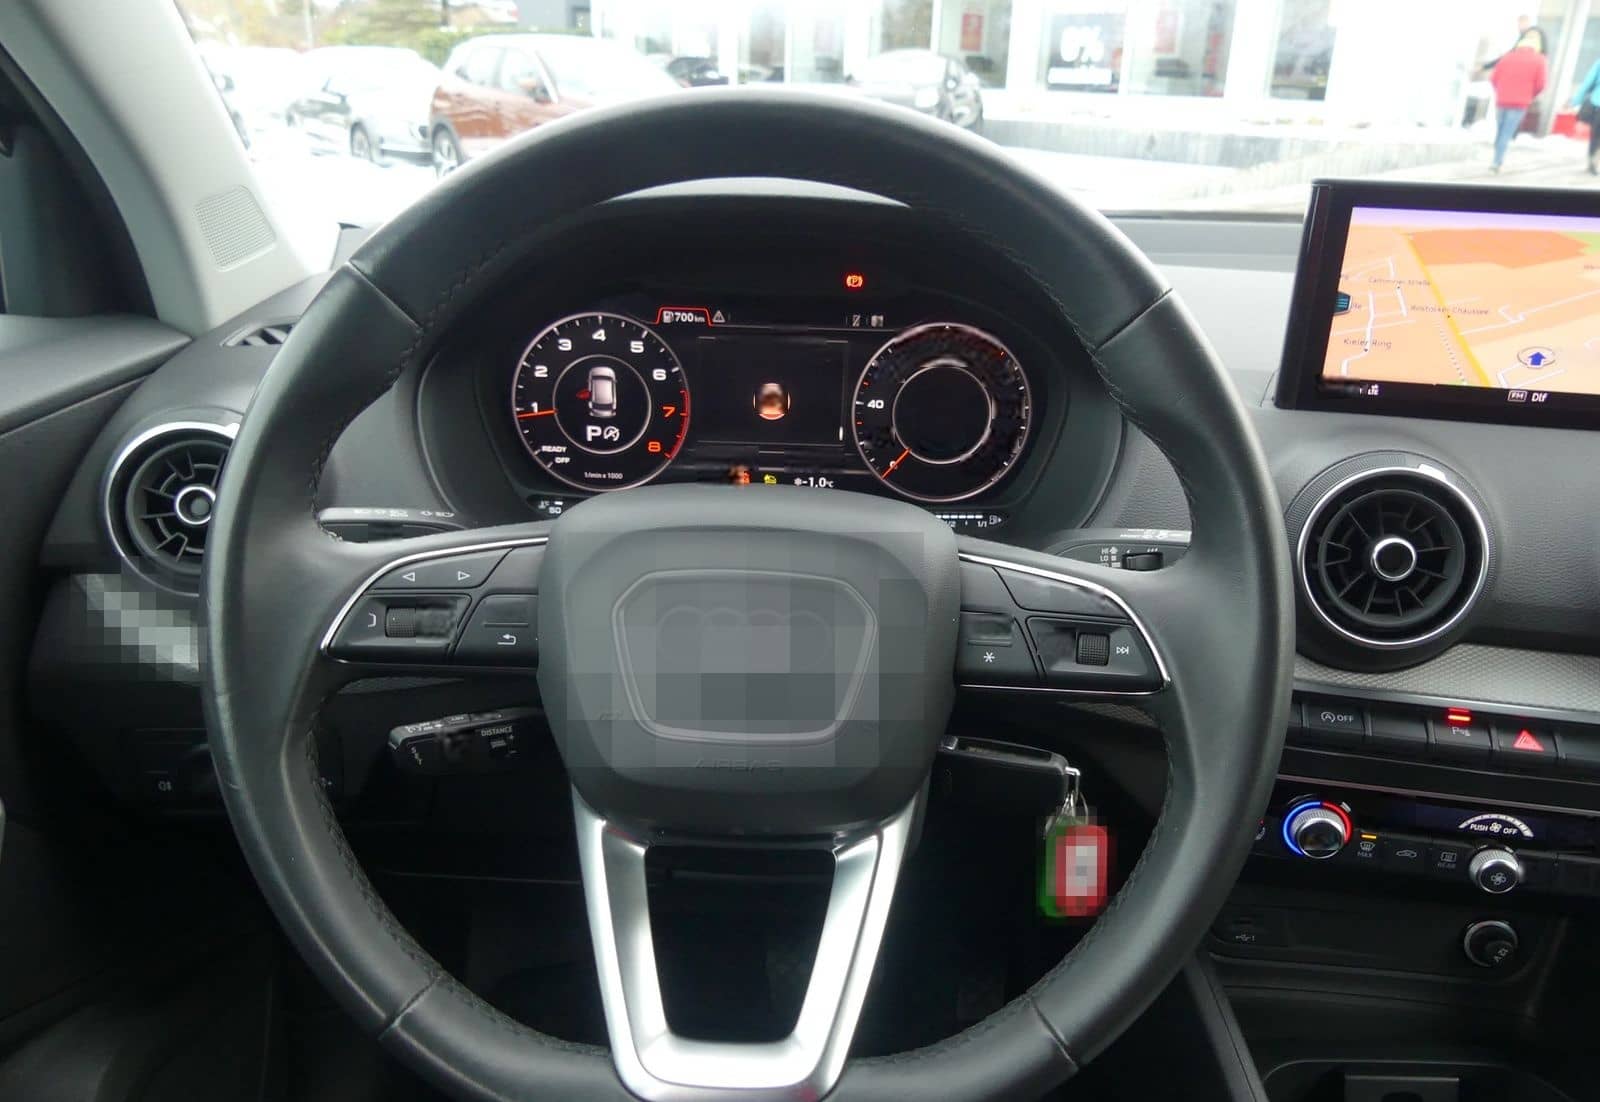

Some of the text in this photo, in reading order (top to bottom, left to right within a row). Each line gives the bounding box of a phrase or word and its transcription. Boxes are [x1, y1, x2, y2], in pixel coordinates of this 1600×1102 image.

[674, 312, 694, 322] 700
[592, 329, 607, 342] 4
[558, 339, 572, 351] 3
[630, 341, 644, 353] 5
[534, 366, 548, 378] 2
[652, 368, 667, 381] 6
[531, 402, 539, 413] 1
[867, 399, 885, 409] 40
[662, 406, 676, 418] 7
[586, 426, 602, 441] P
[541, 445, 567, 453] READY
[648, 441, 661, 452] 8
[481, 725, 513, 737] DISTANCE
[1469, 823, 1518, 835] PUSH OFF
